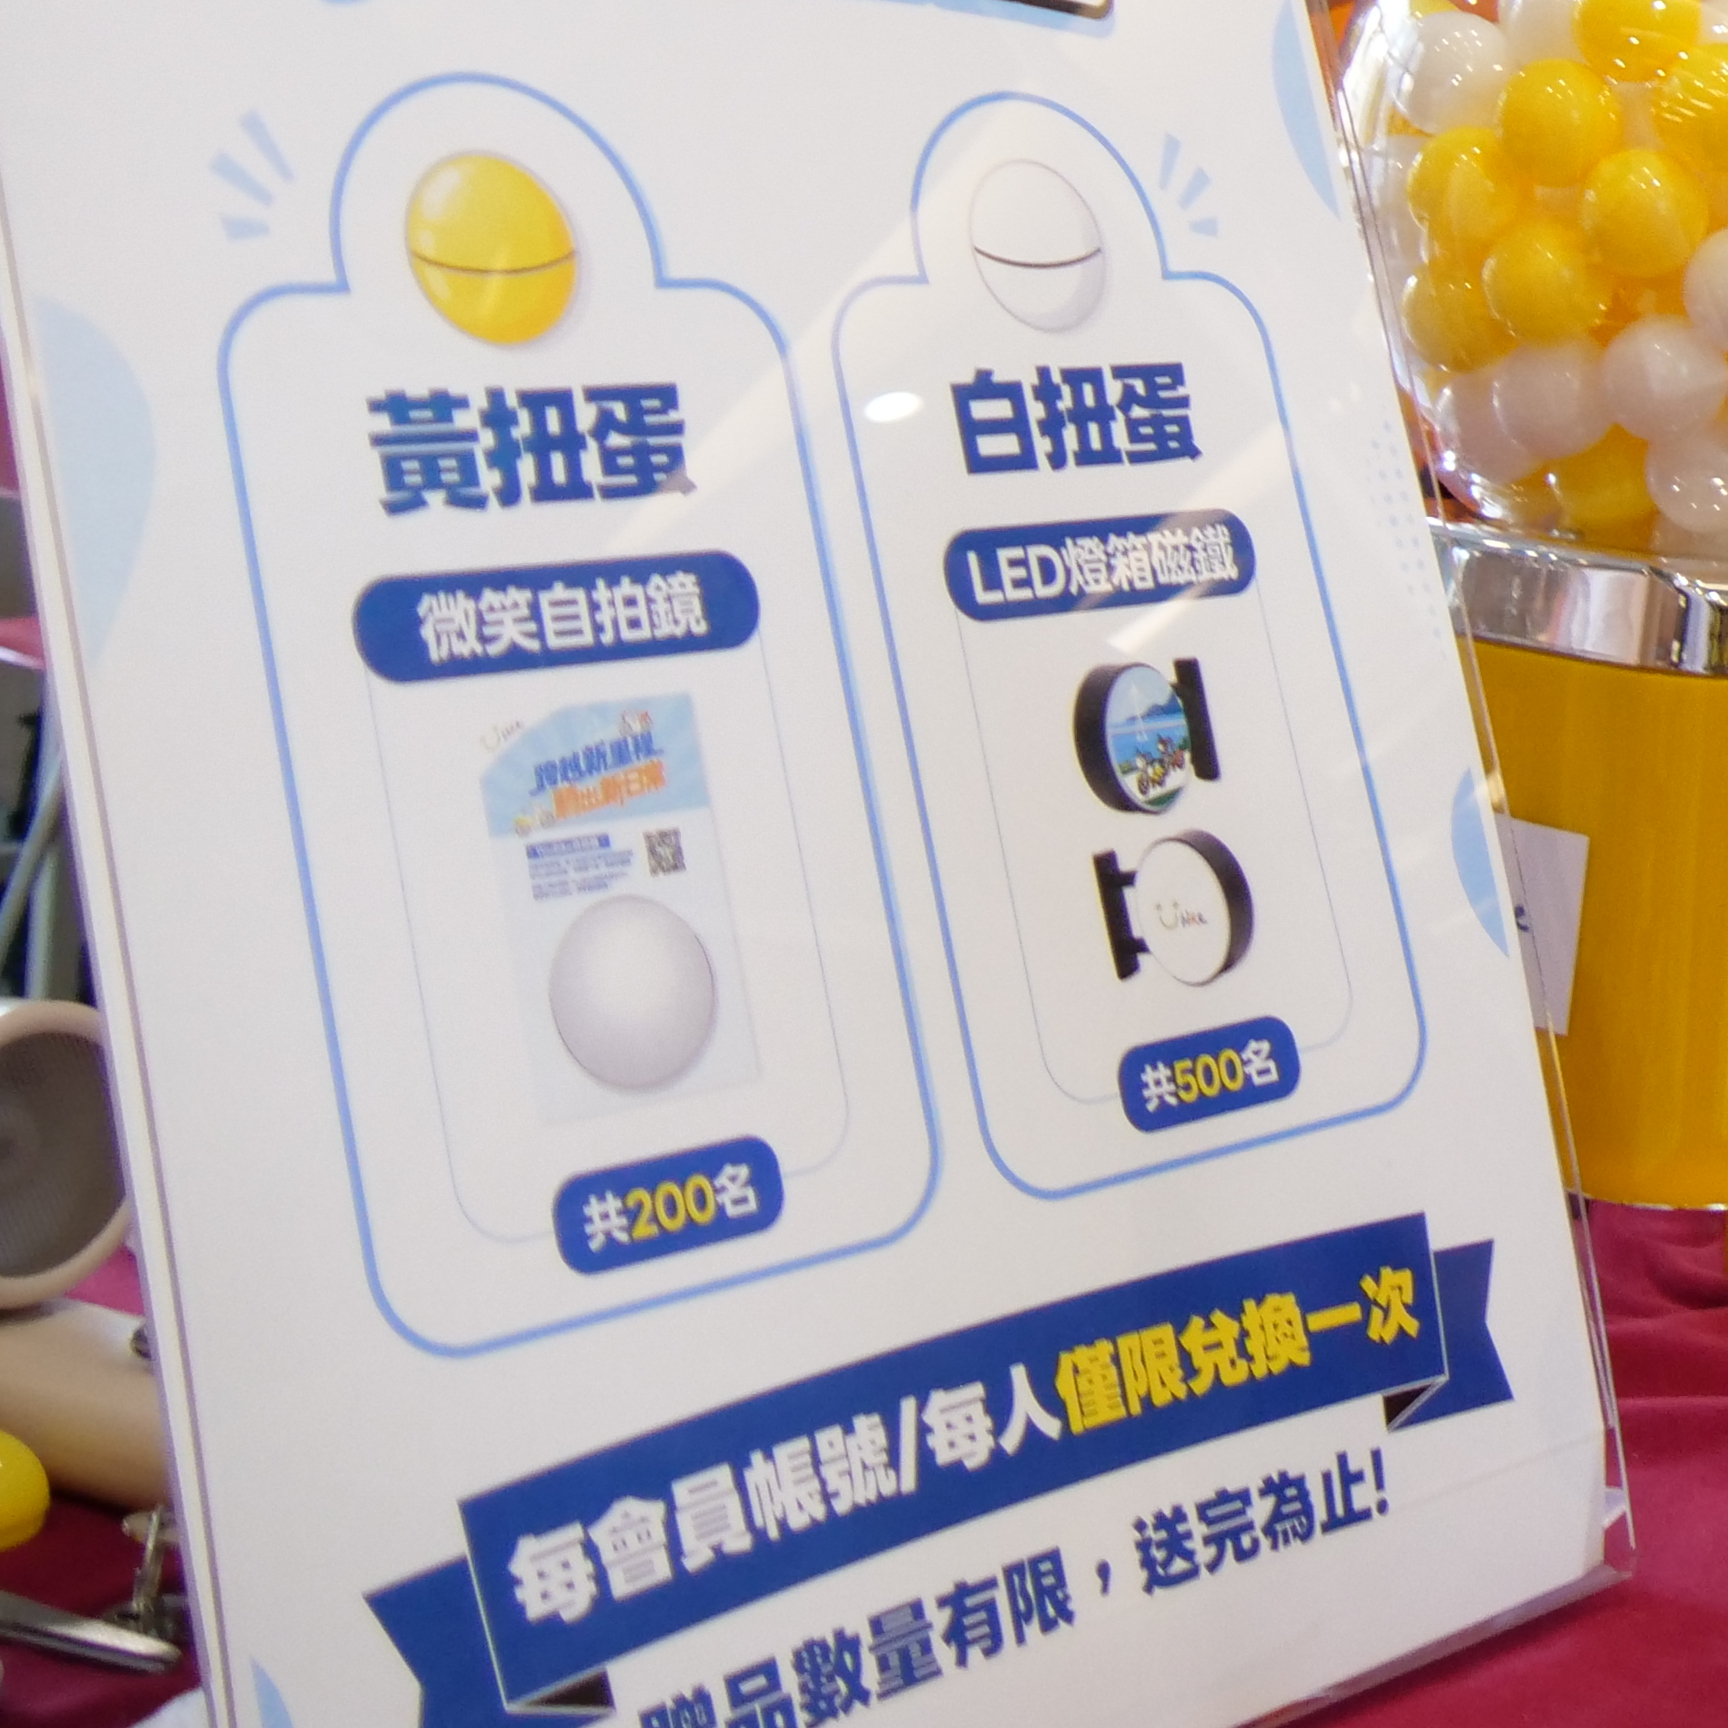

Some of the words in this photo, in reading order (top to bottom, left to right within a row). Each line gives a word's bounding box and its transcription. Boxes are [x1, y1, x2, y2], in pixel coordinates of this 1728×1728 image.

[366, 382, 698, 517] 黃扭蛋
[949, 361, 1203, 475] 白扭蛋
[966, 522, 1240, 606] LED燈箱磁鐵
[416, 570, 711, 666] 微笑自拍鏡
[1140, 1038, 1280, 1113] 共500名
[583, 1162, 760, 1252] 共200名
[508, 1264, 1421, 1626] 每會員帳號/每人僅限兌換一次
